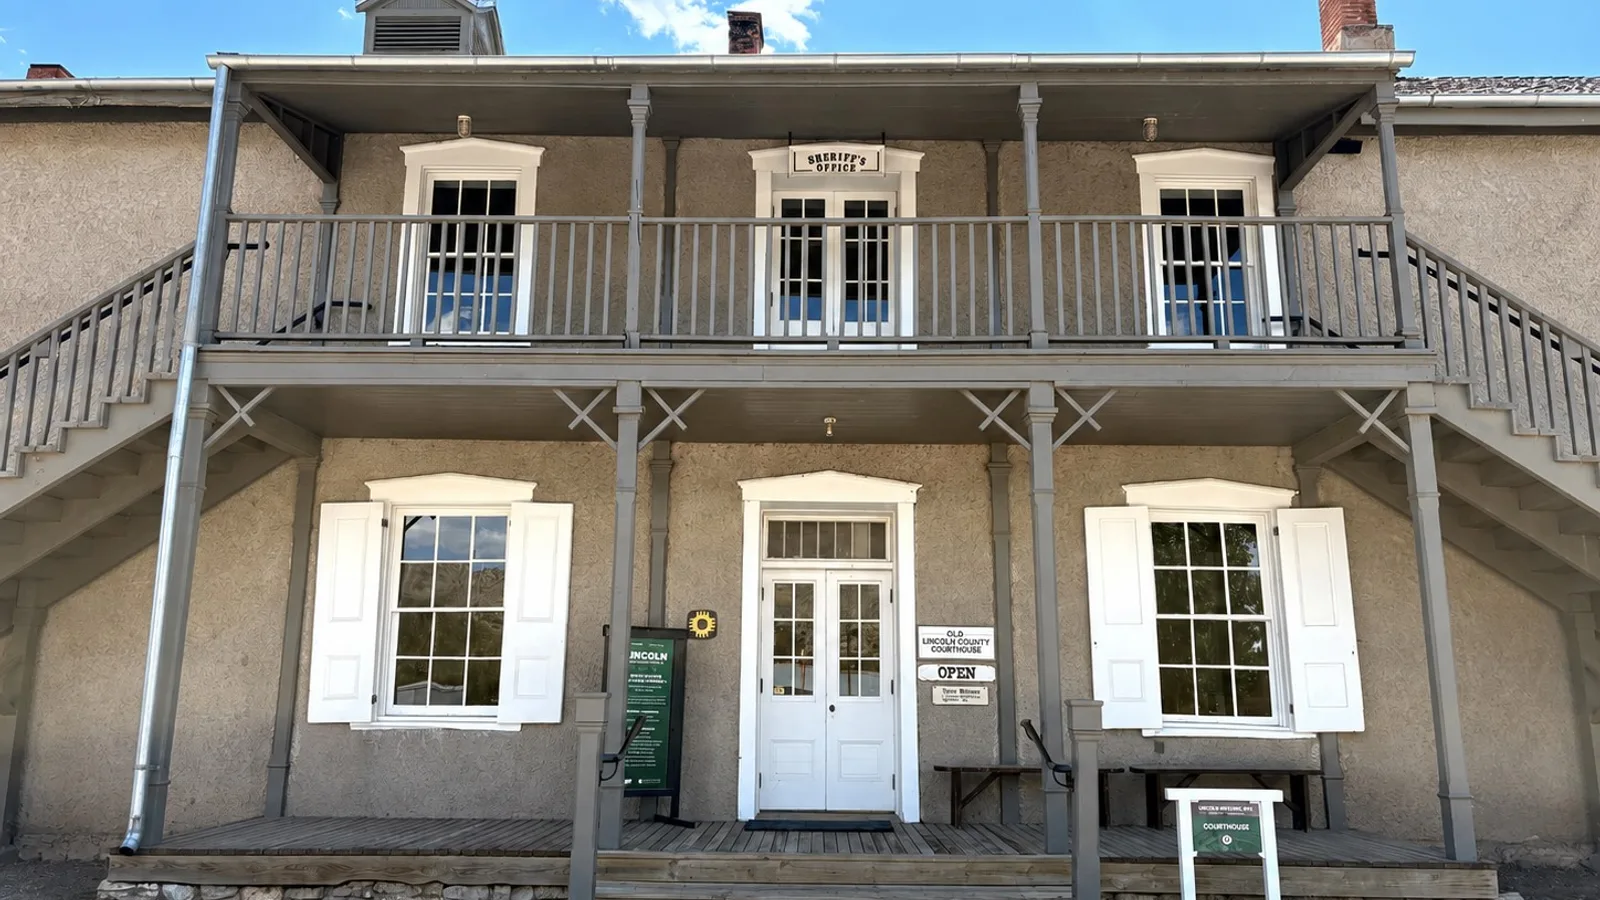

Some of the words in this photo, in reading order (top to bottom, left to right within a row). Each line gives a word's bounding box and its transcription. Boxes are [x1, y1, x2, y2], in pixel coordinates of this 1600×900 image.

[807, 152, 867, 166] SHERIFF'S
[816, 163, 856, 172] OFFICE
[946, 630, 964, 638] OLD
[922, 637, 956, 646] LINCOLN
[957, 637, 990, 646] COUNTY
[931, 645, 982, 654] COURTHOUSE
[629, 650, 668, 661] INCOLN
[938, 666, 976, 679] OPEN
[1203, 822, 1250, 831] COURTHOUSE
